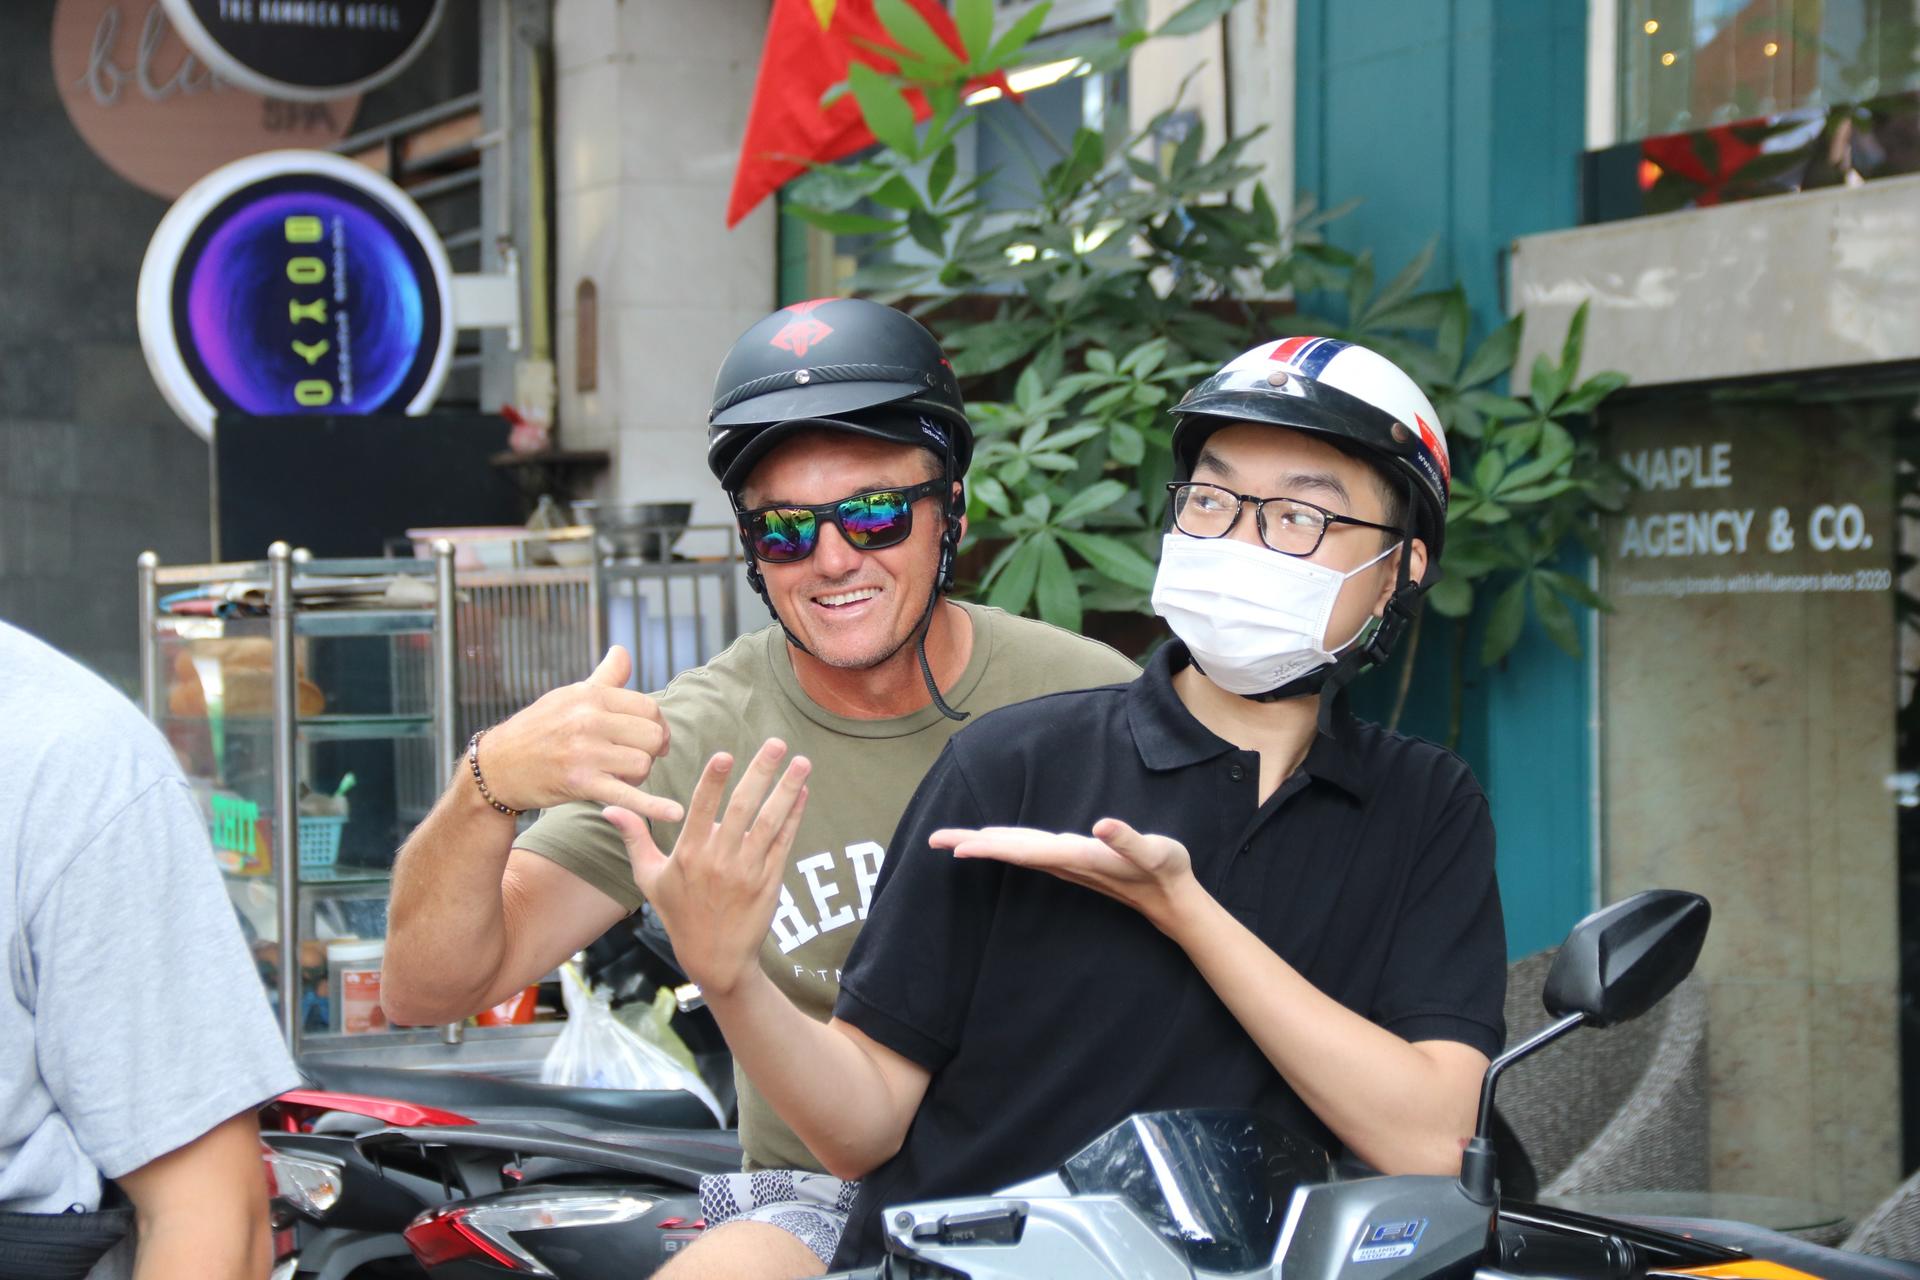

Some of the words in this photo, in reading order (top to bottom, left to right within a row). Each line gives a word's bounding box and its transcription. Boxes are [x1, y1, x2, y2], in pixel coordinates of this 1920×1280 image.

[345, 3, 401, 32] HOTEL
[1620, 442, 1732, 491] MAPLE
[1619, 508, 1754, 558] AGENCY
[1767, 507, 1794, 553] &
[1809, 503, 1874, 551] CO.
[1855, 568, 1892, 591] 2020
